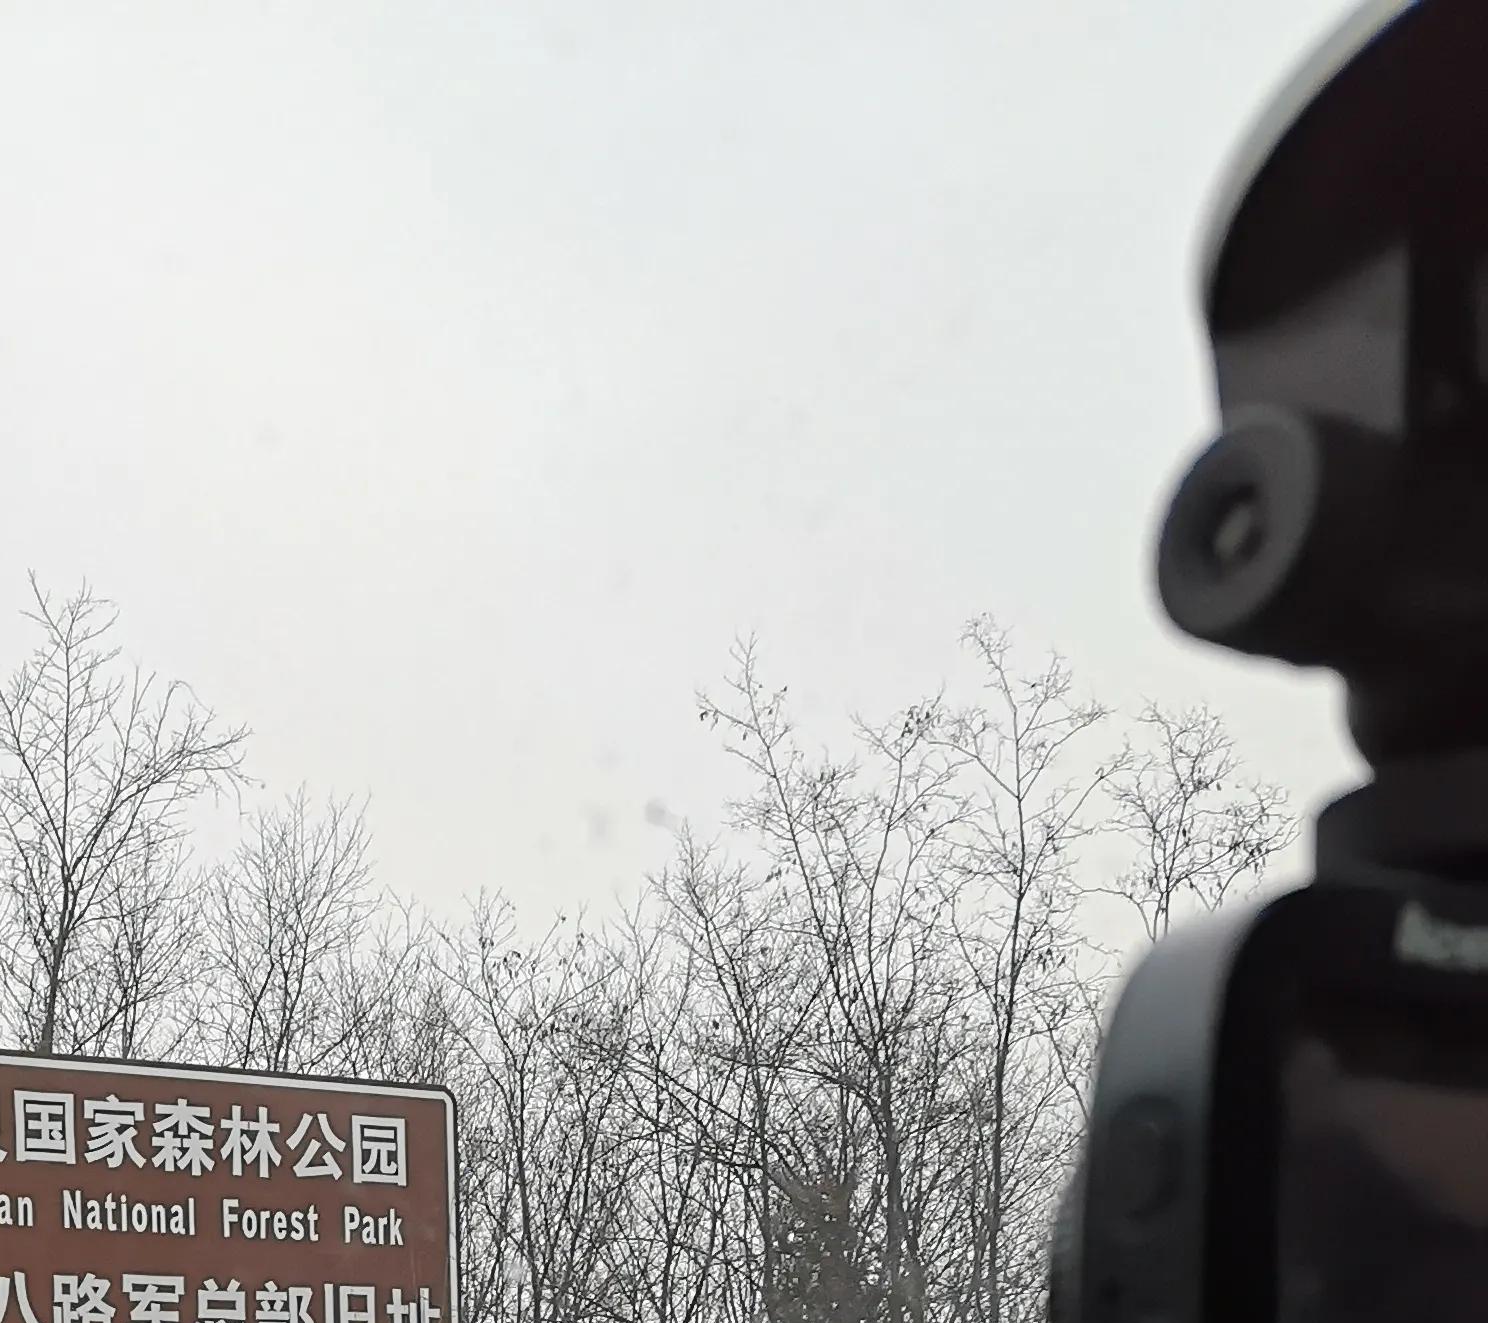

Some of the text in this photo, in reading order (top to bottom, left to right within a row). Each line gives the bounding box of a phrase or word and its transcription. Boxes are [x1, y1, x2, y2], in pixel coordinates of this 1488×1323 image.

[62, 1190, 196, 1236] National
[222, 1198, 319, 1242] Forest
[344, 1206, 404, 1246] Park
